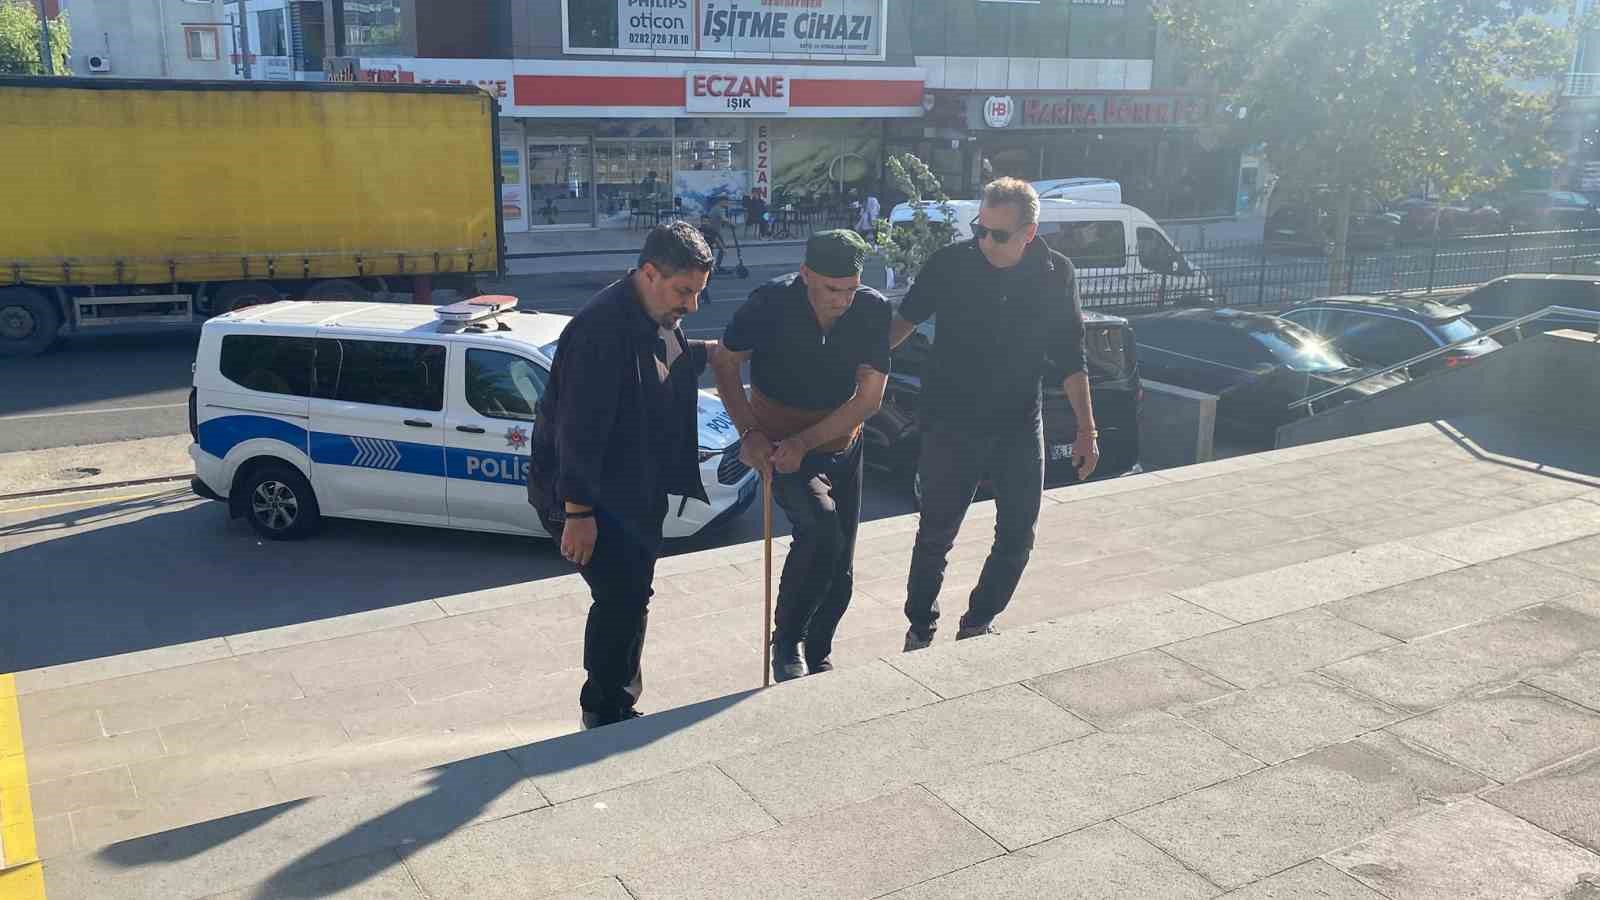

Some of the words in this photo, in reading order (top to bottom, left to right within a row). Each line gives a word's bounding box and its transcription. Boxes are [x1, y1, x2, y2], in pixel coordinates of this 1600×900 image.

[630, 12, 684, 29] oticon
[703, 3, 788, 43] İŞİTME
[793, 12, 872, 41] CİHAZI
[693, 75, 784, 97] ECZANE
[727, 98, 751, 110] IŞIK
[992, 102, 1006, 116] HB
[758, 126, 768, 199] ECZAN
[466, 455, 529, 480] POLİS
